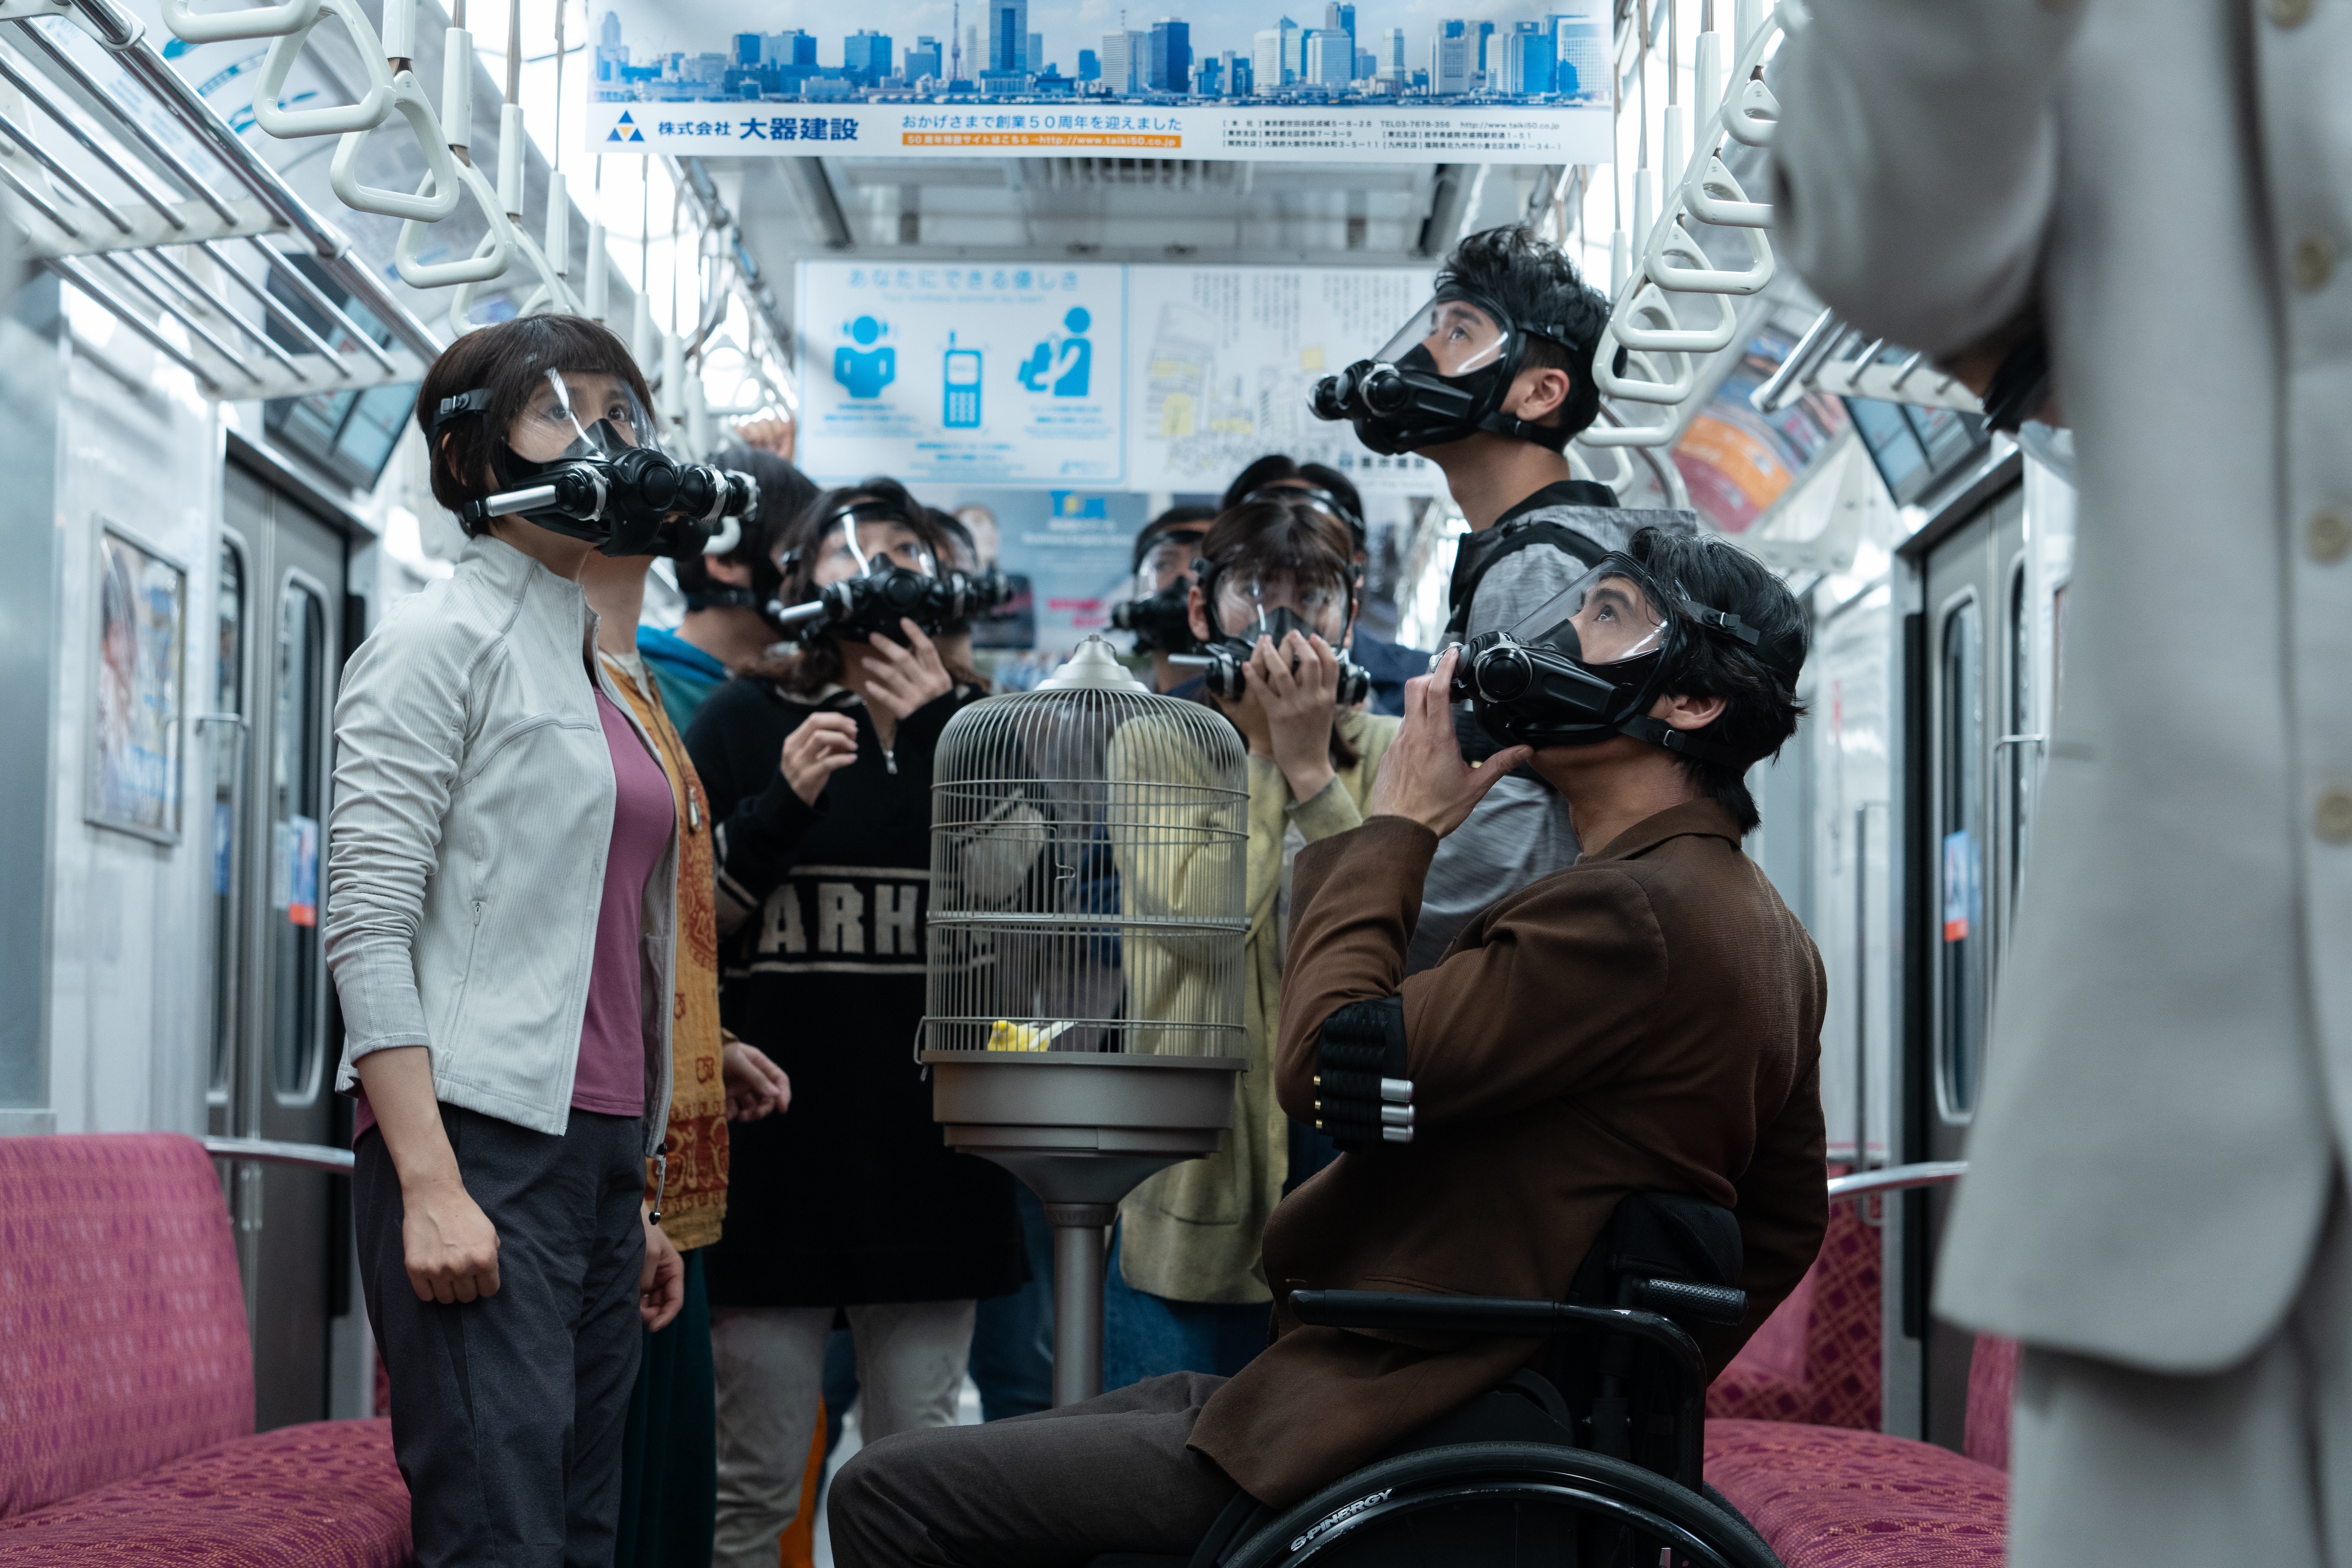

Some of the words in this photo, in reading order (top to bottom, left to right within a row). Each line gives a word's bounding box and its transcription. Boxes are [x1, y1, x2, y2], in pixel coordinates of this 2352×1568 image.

[659, 120, 731, 136] 株式会社
[739, 117, 859, 141] 大器建設
[850, 269, 1078, 290] あなたにできる優しさ
[1290, 1488, 1393, 1552] SPINERGY
